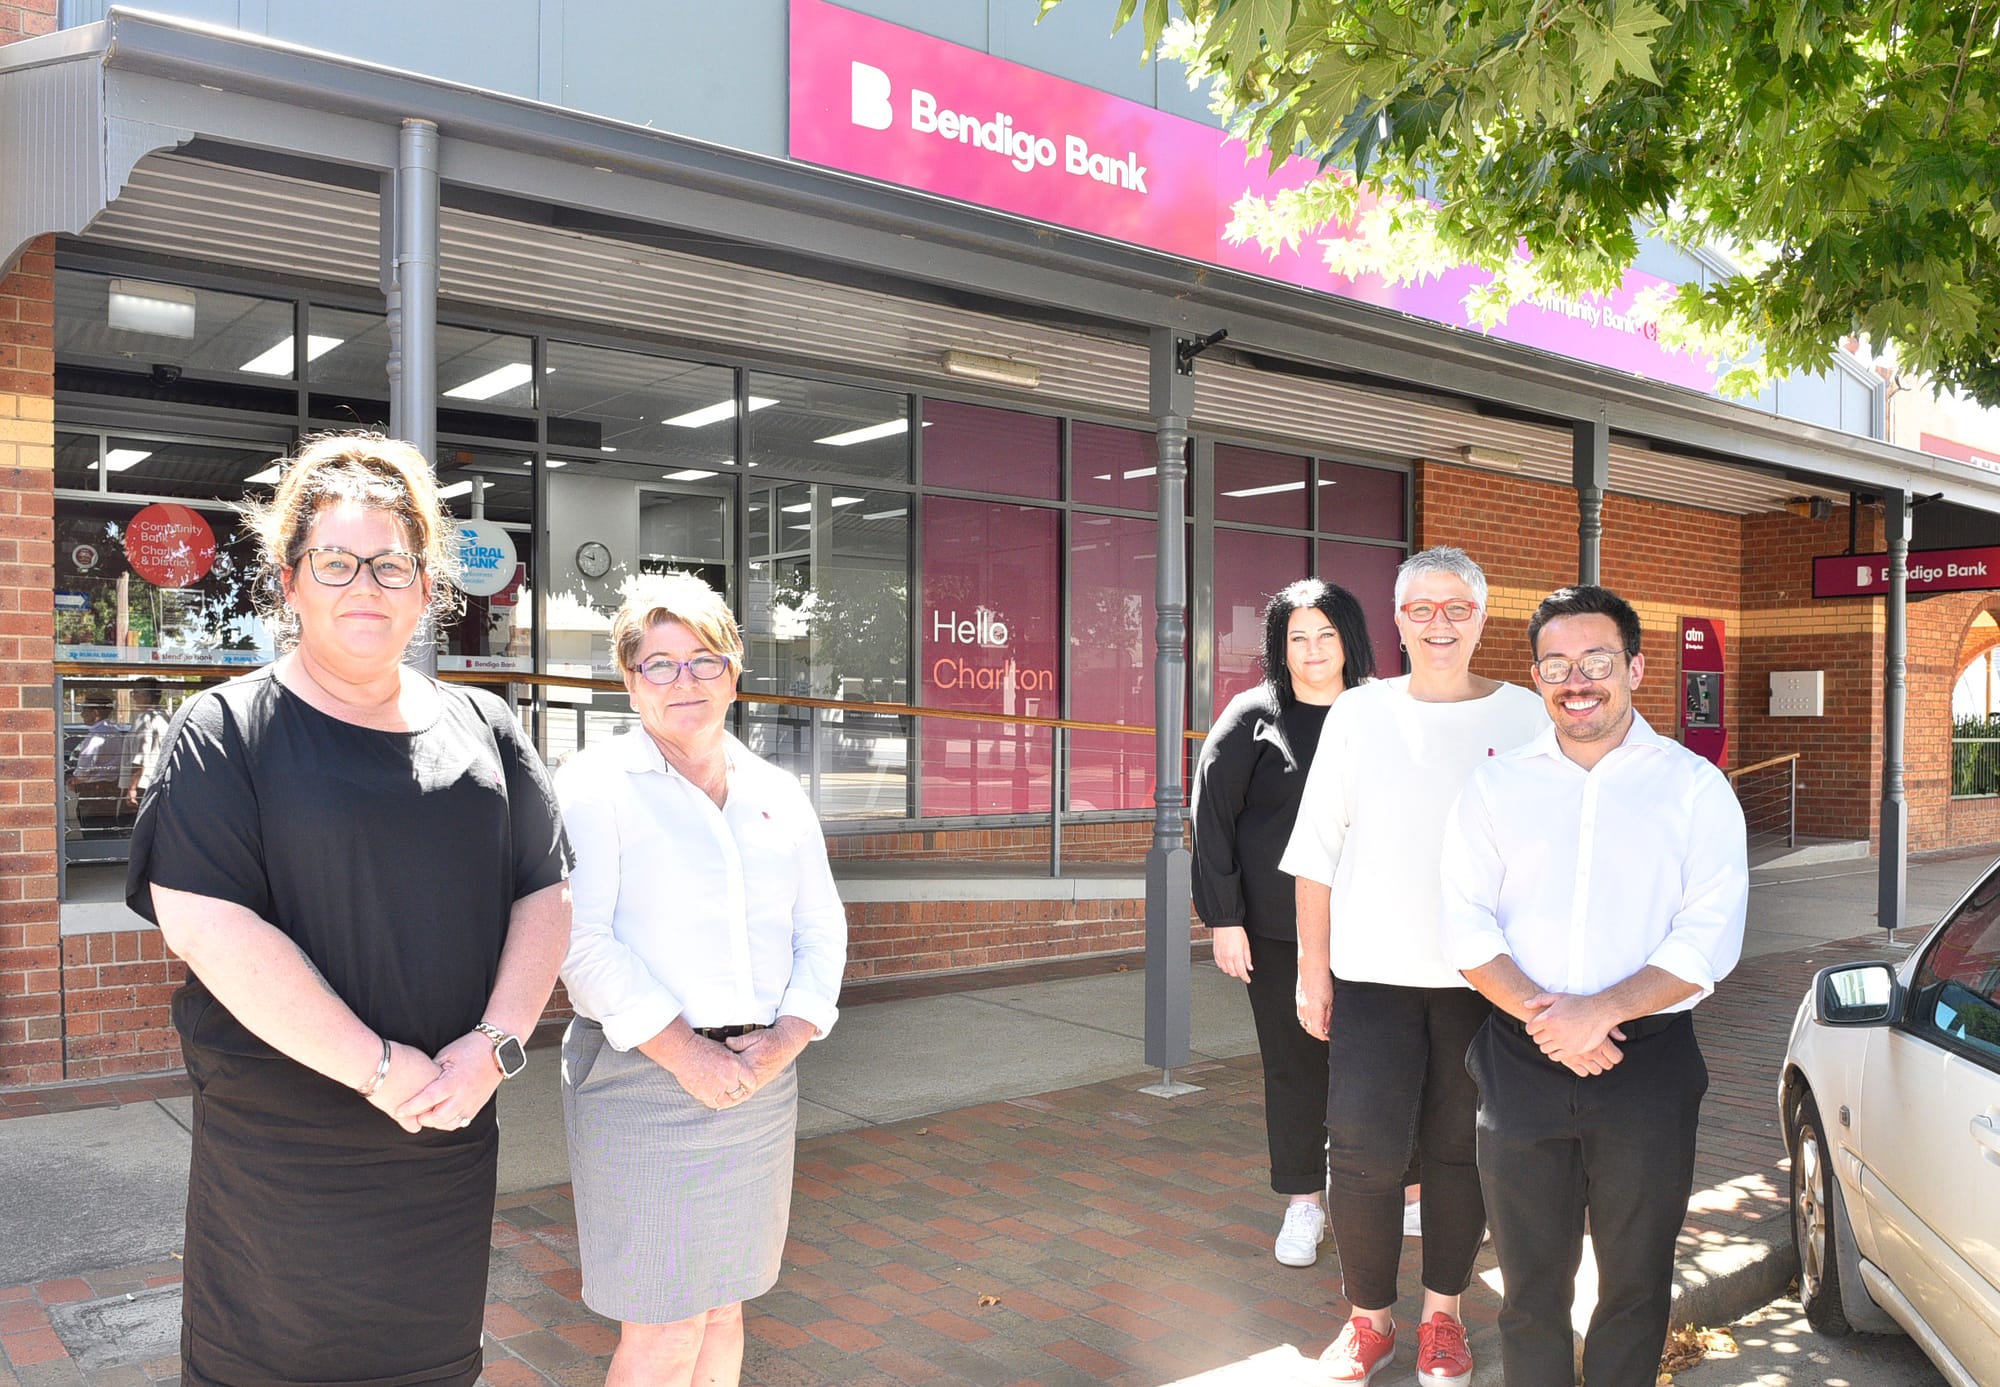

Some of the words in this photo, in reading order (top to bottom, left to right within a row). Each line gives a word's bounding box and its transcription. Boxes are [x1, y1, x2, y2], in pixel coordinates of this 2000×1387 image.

[911, 88, 1057, 172] Bendigo
[1065, 134, 1148, 194] Bank
[1603, 306, 1635, 334] Bank
[140, 521, 203, 536] Community
[140, 532, 168, 542] Bank
[140, 545, 188, 557] Charl
[460, 546, 504, 559] RURAL
[141, 556, 149, 565] &
[152, 556, 190, 567] District
[1881, 565, 1943, 582] Bdigo
[1947, 561, 1987, 577] Bank
[934, 610, 1008, 645] Hello
[1685, 627, 1704, 642] atm
[474, 661, 500, 669] Bendigo
[933, 658, 1053, 691] Charlton
